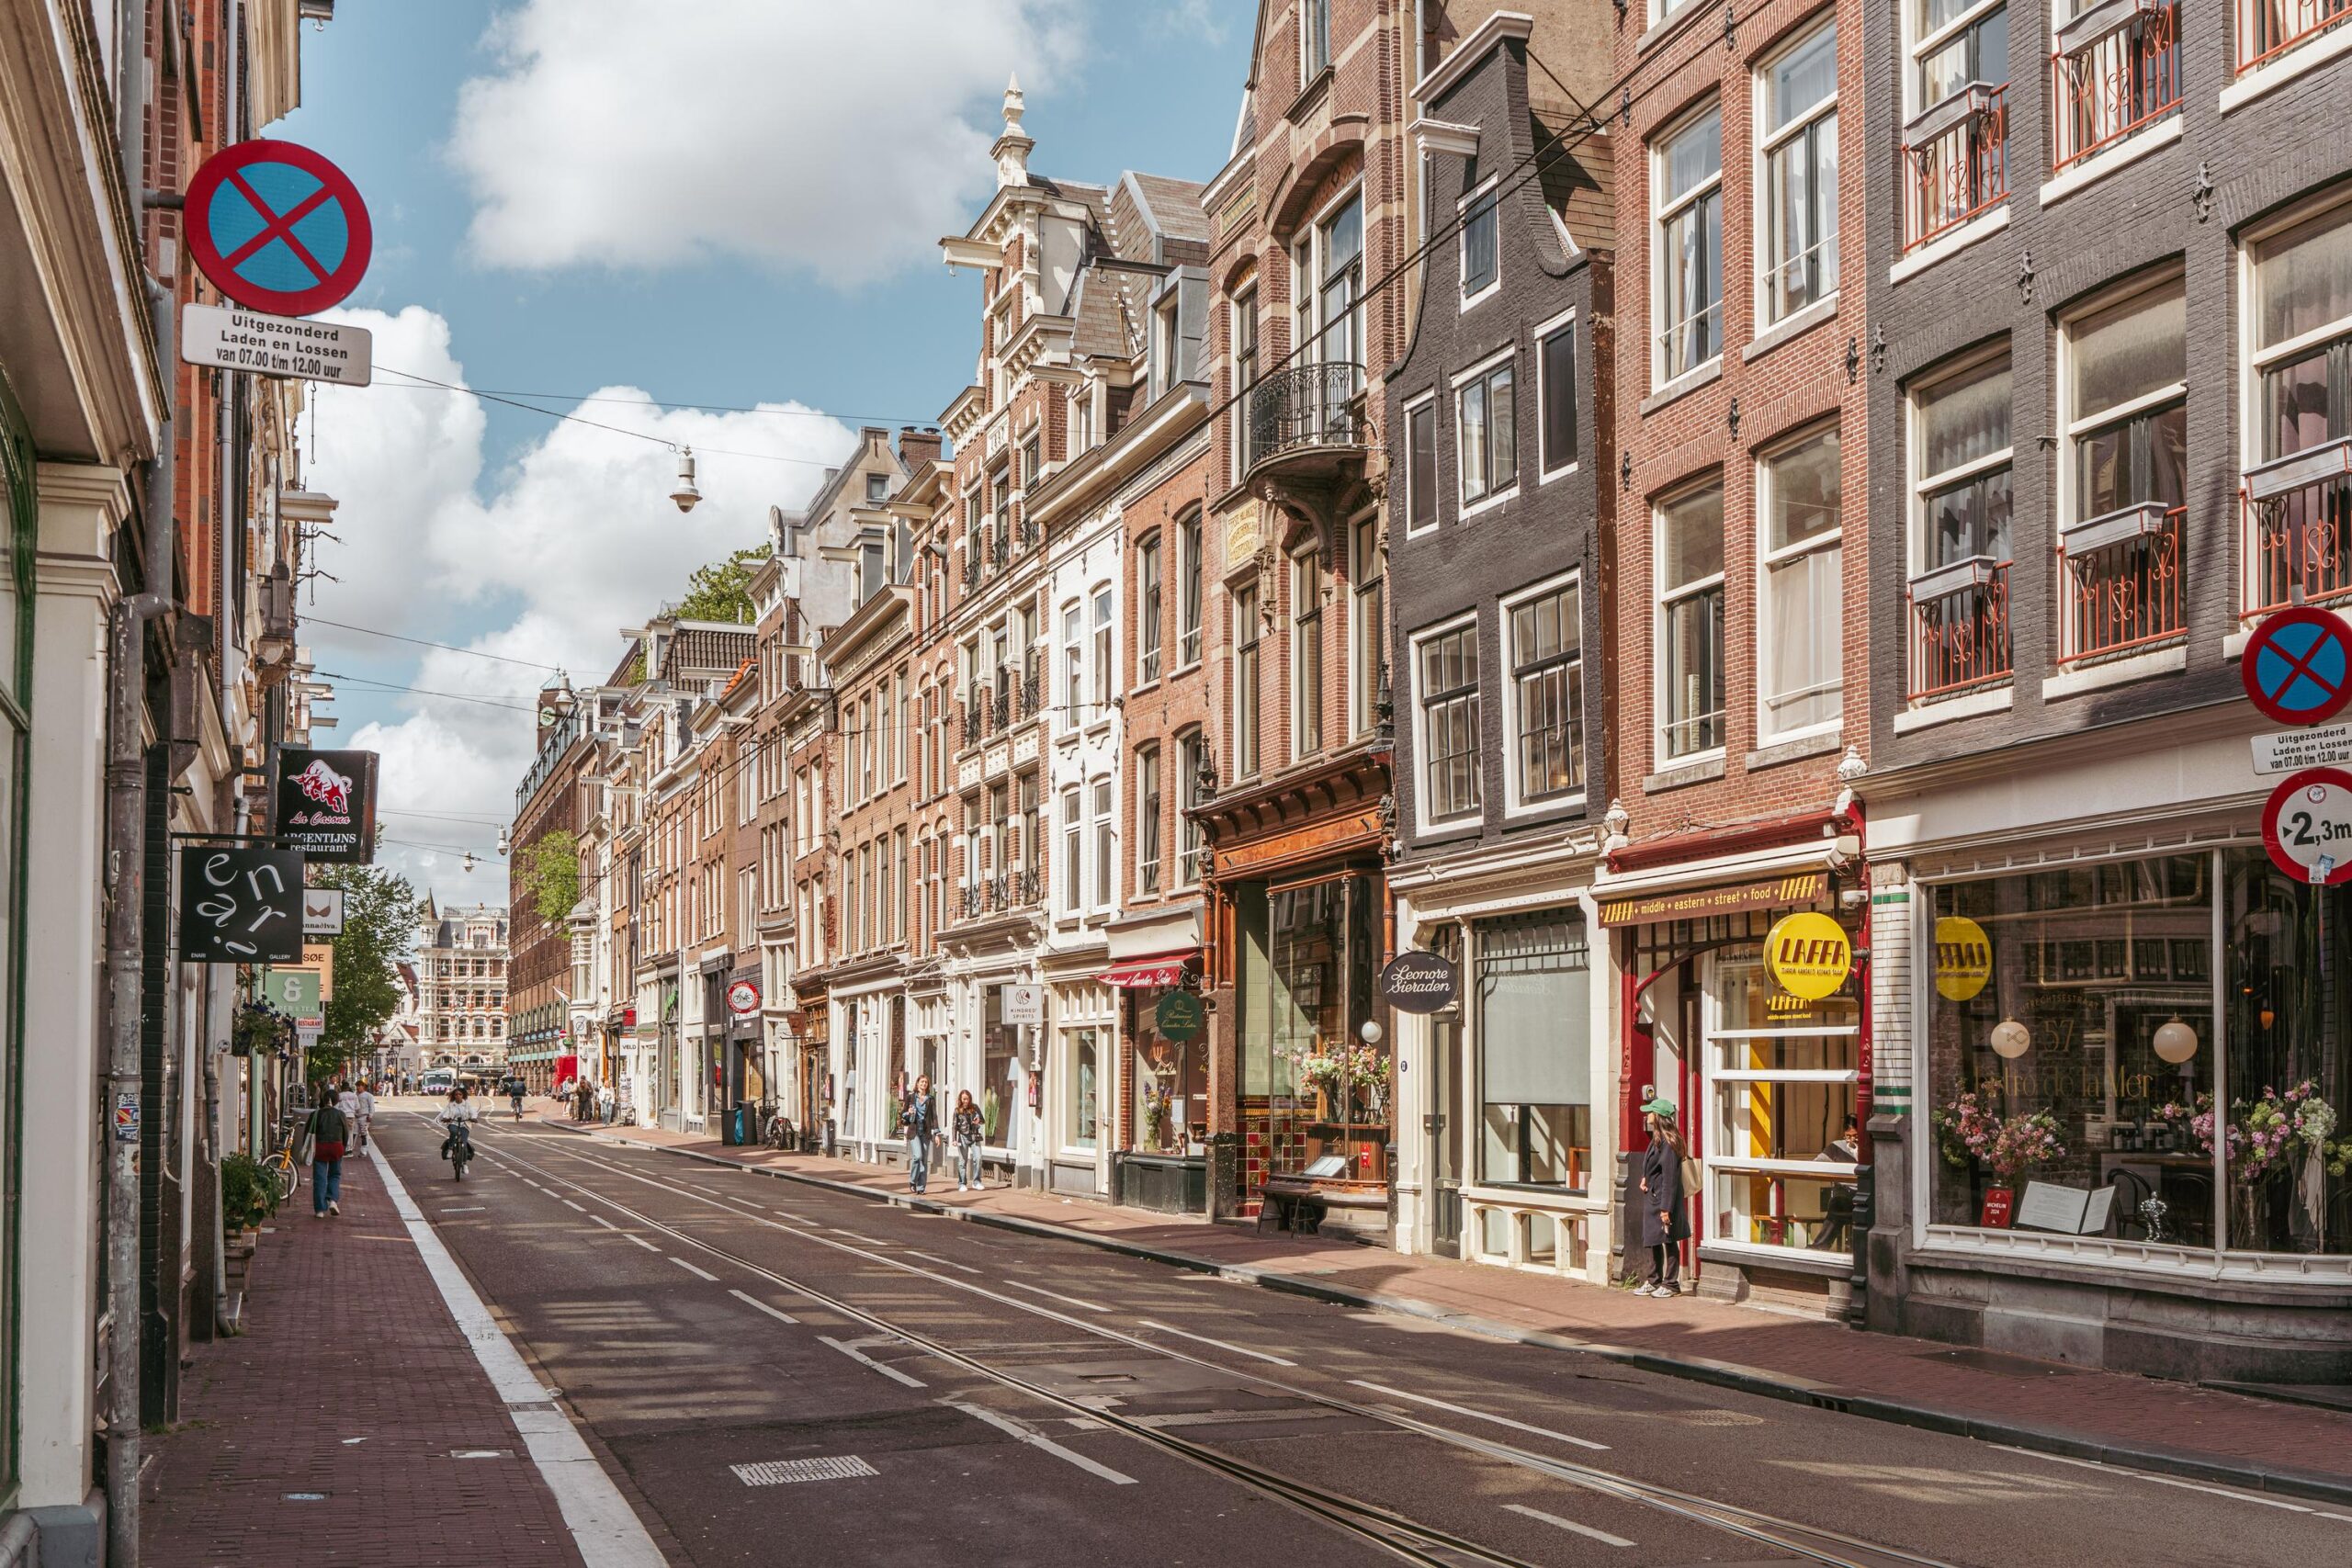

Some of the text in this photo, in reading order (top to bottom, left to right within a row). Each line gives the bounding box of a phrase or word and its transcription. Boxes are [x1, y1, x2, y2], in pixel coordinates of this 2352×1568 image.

[232, 314, 339, 342] Uitgezonderd
[221, 330, 348, 359] Laden en Lossen
[216, 348, 342, 378] van 07.00 t/m 12.00 uur
[2273, 746, 2301, 756] Laden
[2320, 739, 2352, 750] Lossen
[2278, 728, 2346, 744] Uitgezonderd
[2270, 760, 2283, 770] van
[2284, 755, 2303, 767] 07.00
[2317, 750, 2336, 762] 12.00
[2337, 750, 2350, 761] uur
[289, 811, 351, 826] La Casona
[2291, 811, 2352, 846] 2,3m
[290, 843, 348, 852] restaurant
[1603, 875, 1816, 923] LAFFA middle eastern street food LAFFA
[1779, 938, 1846, 965] LAFFA
[1391, 964, 1448, 980] Leonore
[1386, 979, 1451, 993] Sieraden
[2044, 1020, 2075, 1053] 57
[2043, 1066, 2074, 1097] de
[2083, 1066, 2099, 1097] la
[2107, 1066, 2154, 1097] Mer
